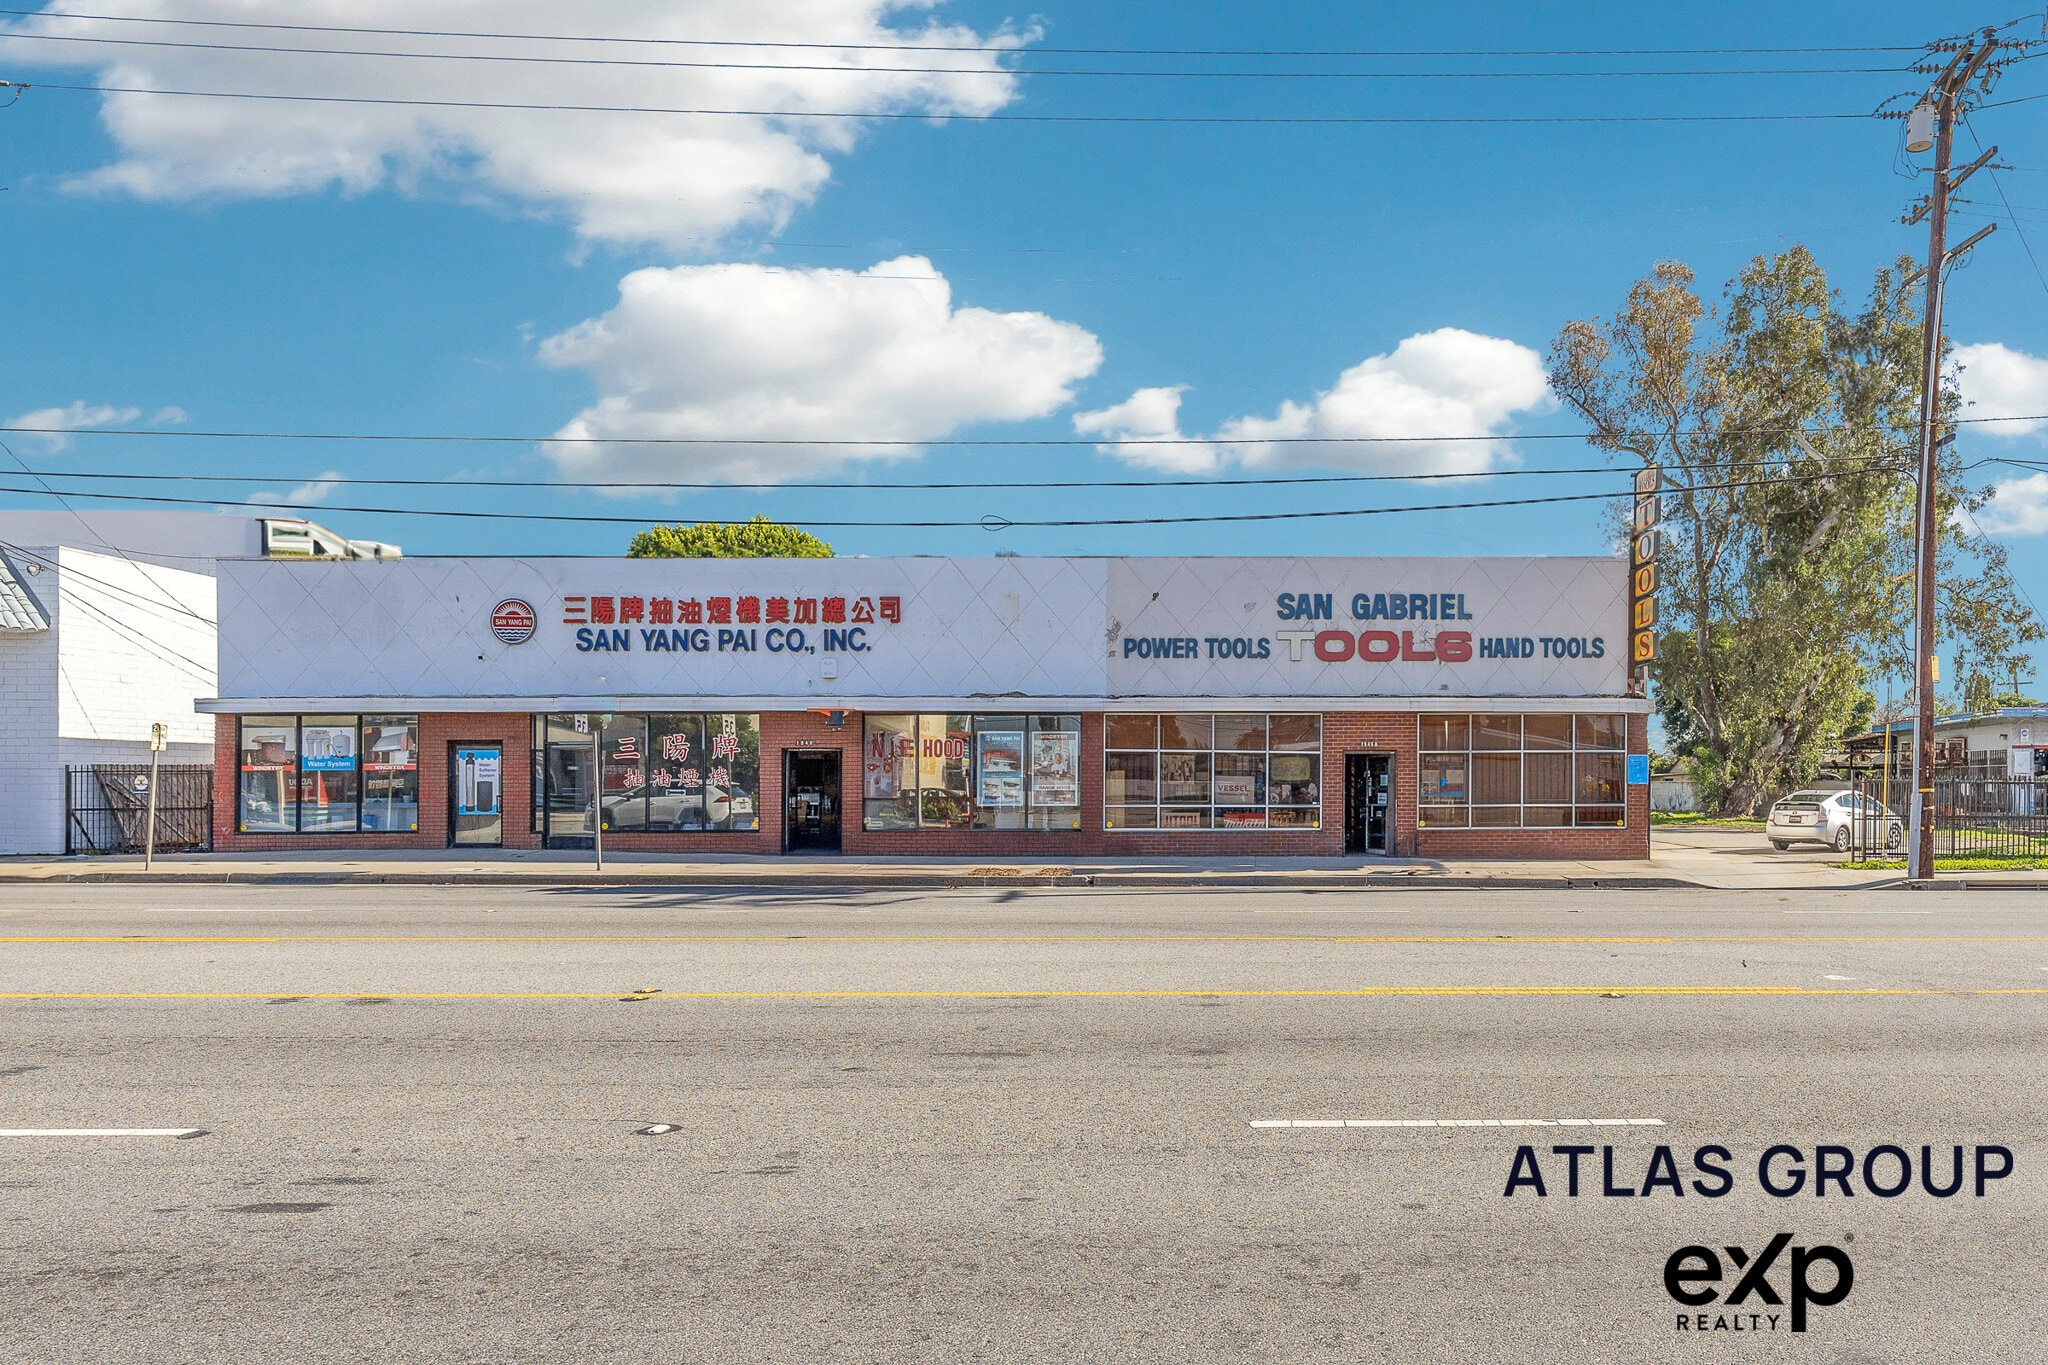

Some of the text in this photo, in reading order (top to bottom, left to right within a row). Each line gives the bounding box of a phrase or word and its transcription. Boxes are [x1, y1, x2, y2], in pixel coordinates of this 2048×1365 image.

[1638, 502, 1653, 657] TOOLS
[563, 596, 901, 624] 三陽牌抽油煙機美加總公司
[1277, 593, 1473, 620] SAN GABRIEL
[576, 628, 872, 655] SAN YANG PAI CO., INC.
[1124, 638, 1270, 659] POWER TOOLS
[1479, 637, 1605, 659] HAND TOOLS
[923, 739, 964, 758] HOOD
[327, 760, 351, 769] System
[1217, 784, 1250, 792] VESSEL
